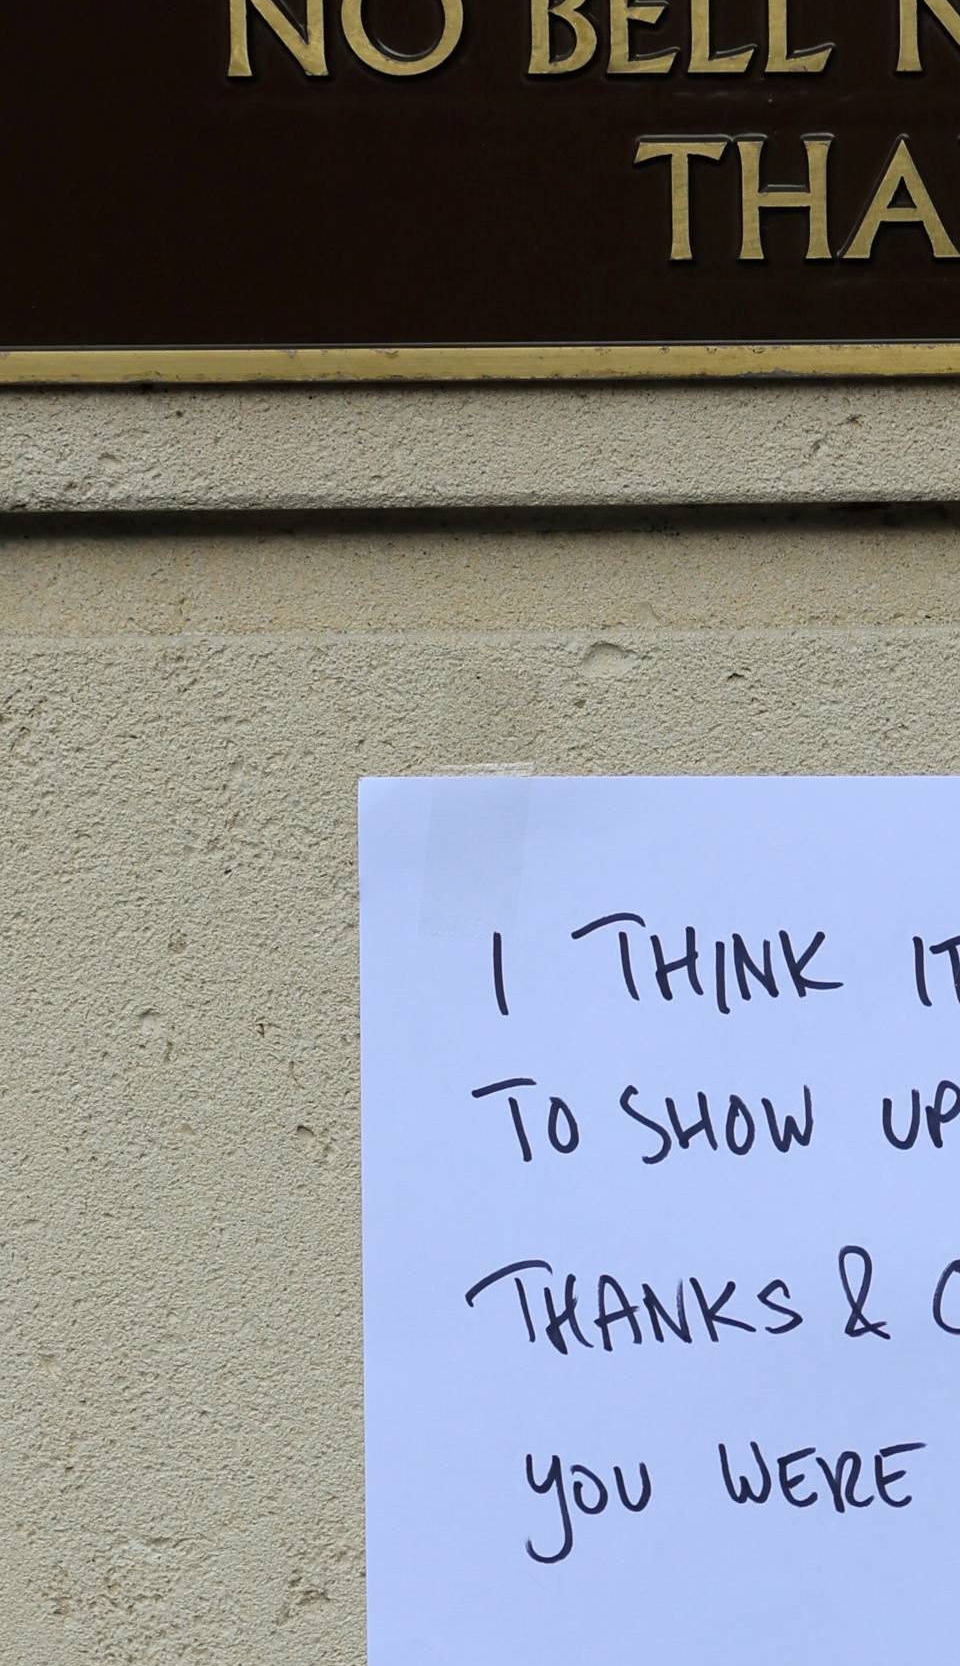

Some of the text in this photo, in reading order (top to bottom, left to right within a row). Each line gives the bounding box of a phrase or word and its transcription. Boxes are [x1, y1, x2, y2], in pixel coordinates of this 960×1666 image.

[493, 932, 509, 1015] I
[571, 913, 843, 1014] THINK
[472, 1078, 580, 1162] TO
[620, 1085, 814, 1164] SHOW
[465, 1260, 803, 1355] THANKS
[839, 1246, 890, 1339] &
[718, 1442, 926, 1513] WERE
